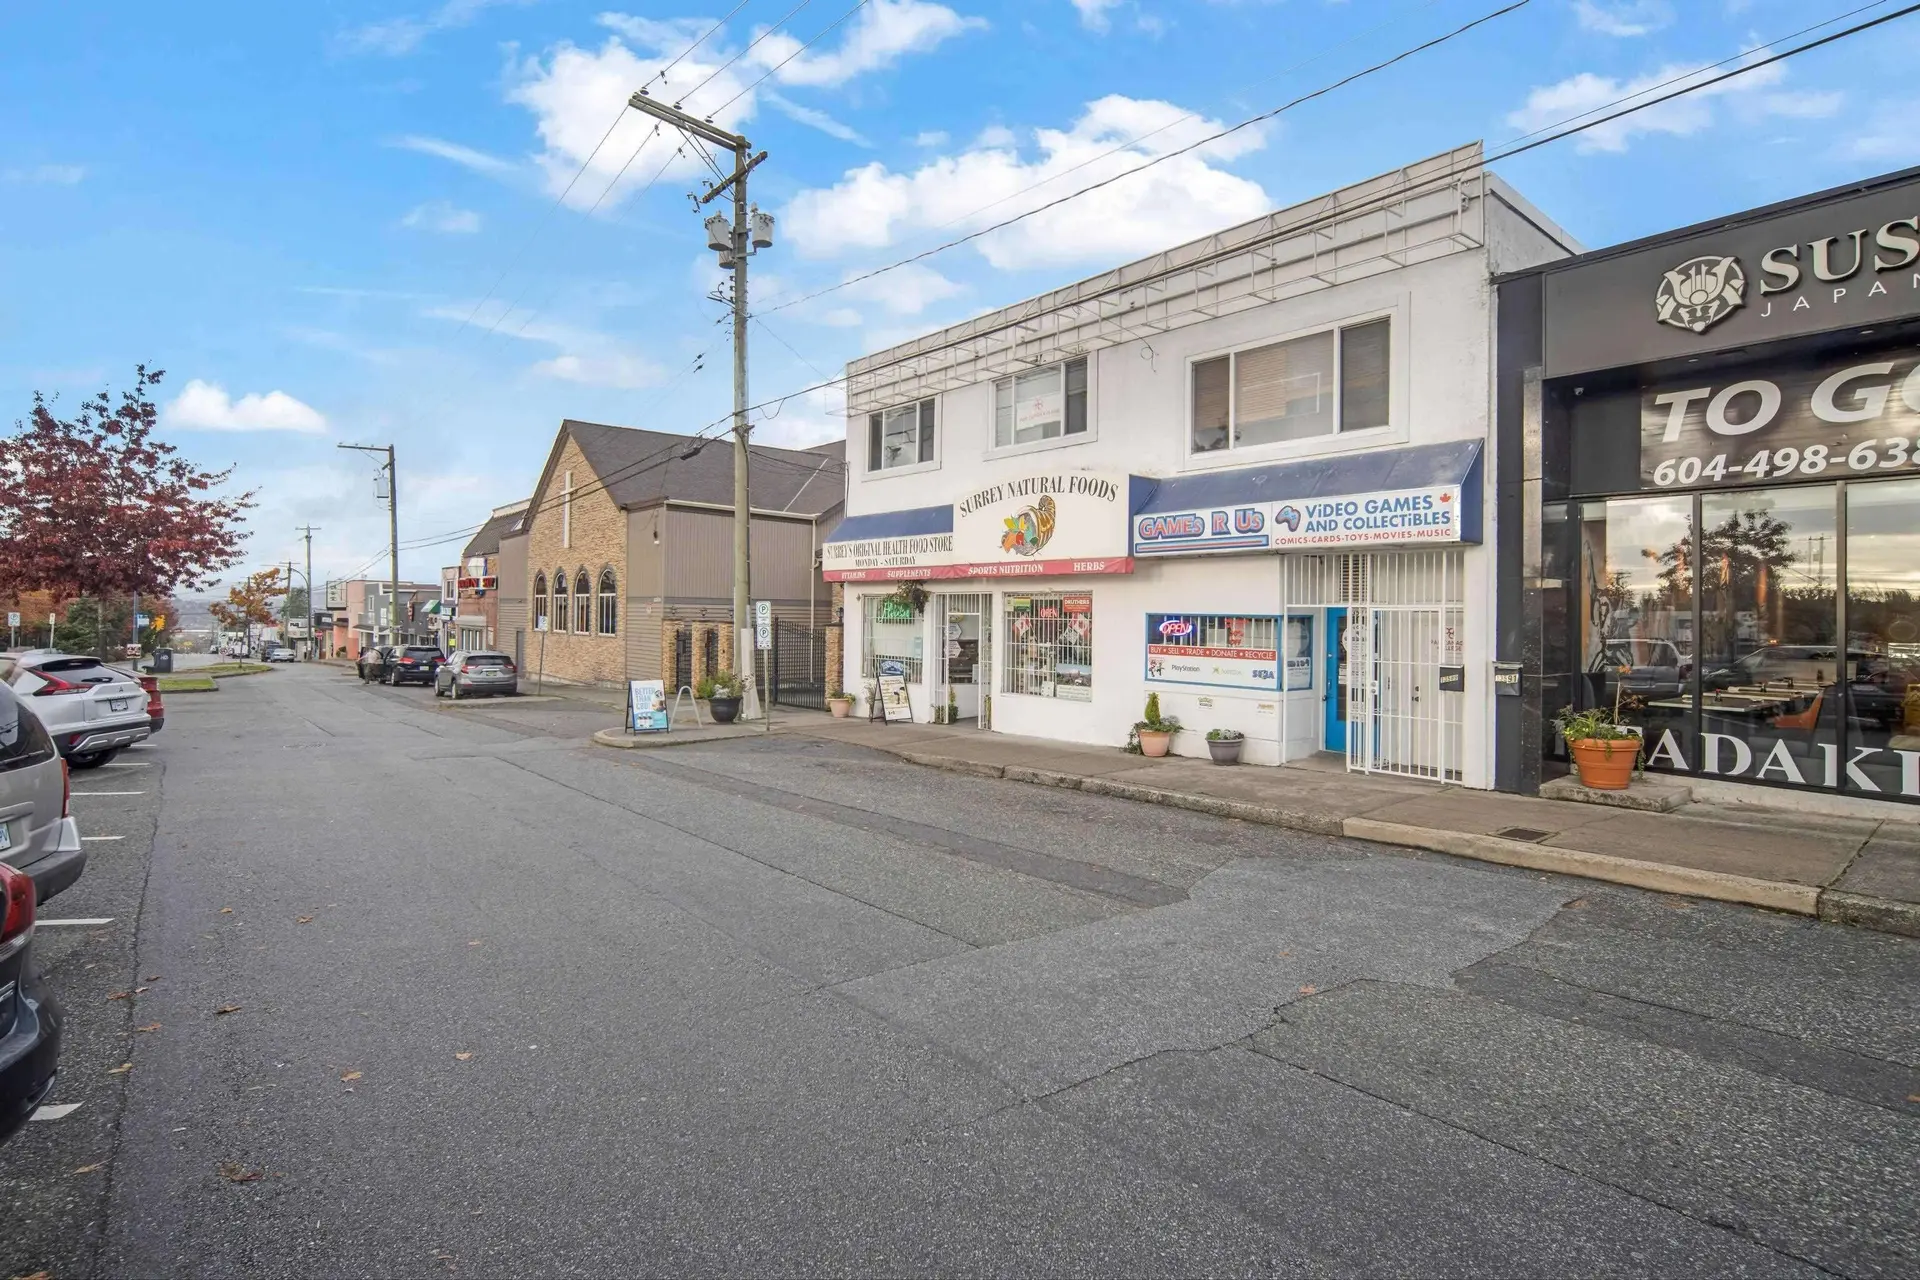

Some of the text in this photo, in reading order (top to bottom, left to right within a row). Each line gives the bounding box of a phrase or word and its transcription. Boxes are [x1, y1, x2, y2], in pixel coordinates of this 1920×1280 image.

[1654, 362, 1920, 443] TO G
[959, 476, 1119, 518] SURREY NATURAL FOODS
[1364, 494, 1434, 514] GAMES
[1211, 511, 1231, 536] R
[1305, 518, 1338, 533] AND
[853, 540, 882, 557] ORIGINAL
[882, 539, 909, 556] HEALTH
[909, 537, 929, 553] FOOD
[929, 535, 953, 553] STORE
[855, 555, 917, 567] MONDAY SATURDAY
[887, 568, 932, 578] SUPPLEMENTS
[968, 565, 998, 575] SPORTS
[999, 564, 1044, 574] NUTRITION
[1073, 561, 1105, 572] HERBS
[1161, 622, 1190, 634] OPEN
[1168, 647, 1180, 655] SELL
[1186, 648, 1205, 656] TRADE
[1211, 650, 1238, 658] DONATE
[1244, 651, 1274, 660] RECYCLE
[1171, 664, 1201, 673] PlayStation
[1612, 725, 1920, 797] ADAKI
